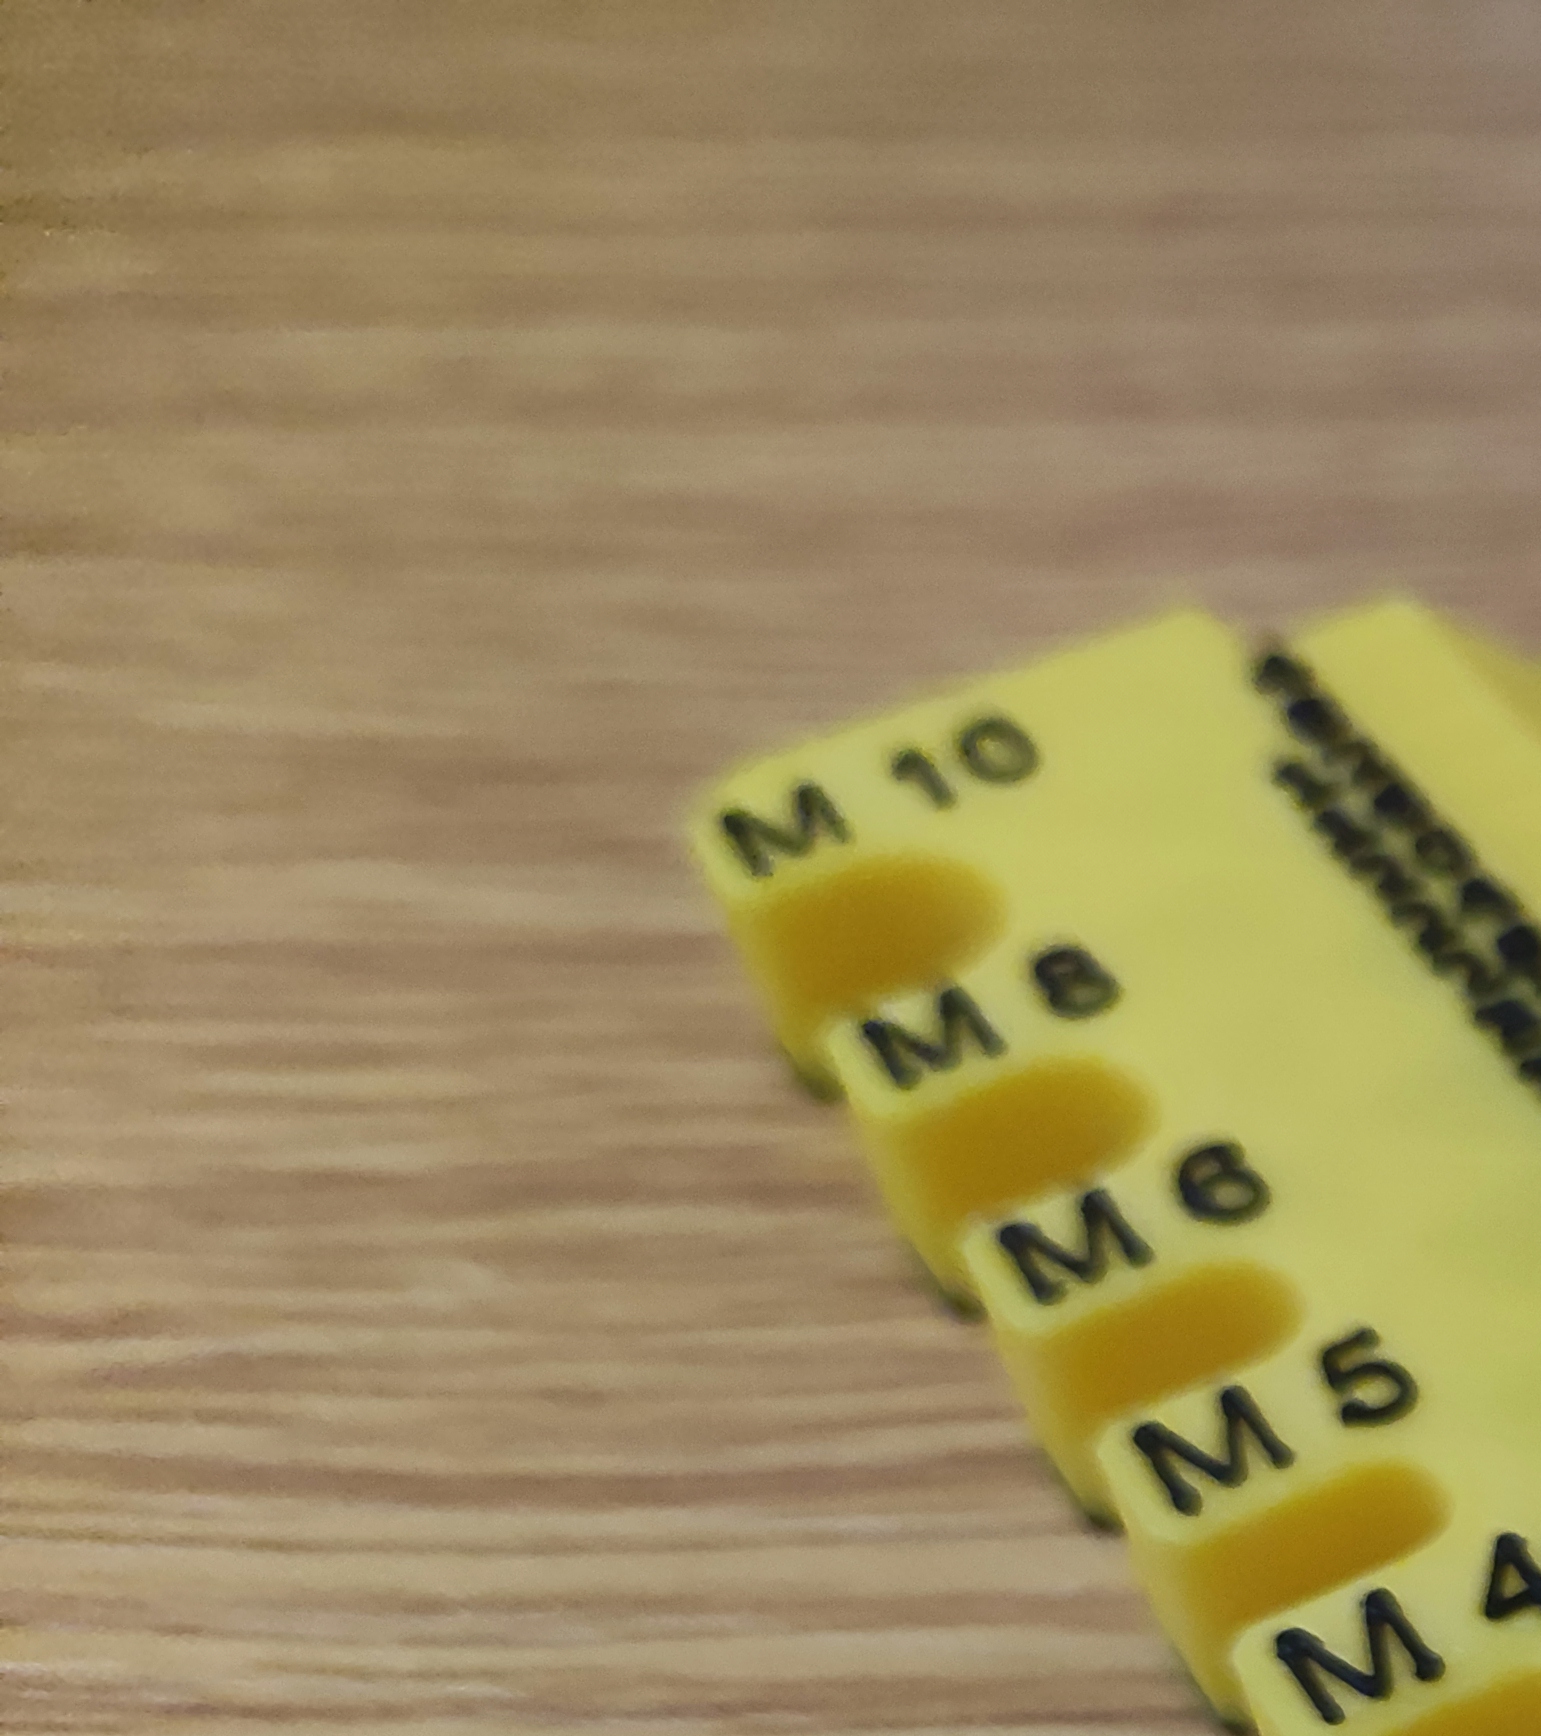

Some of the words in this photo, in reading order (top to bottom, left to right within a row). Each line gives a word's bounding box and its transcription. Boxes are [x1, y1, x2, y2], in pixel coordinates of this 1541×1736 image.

[723, 783, 851, 879] M
[889, 712, 1039, 808] 10
[862, 984, 1006, 1090] M
[1029, 943, 1121, 1020] 8
[997, 1187, 1156, 1305] M
[1173, 1139, 1272, 1224] 6
[1131, 1384, 1297, 1514] M
[1317, 1326, 1419, 1427] 5
[1275, 1586, 1446, 1725] M
